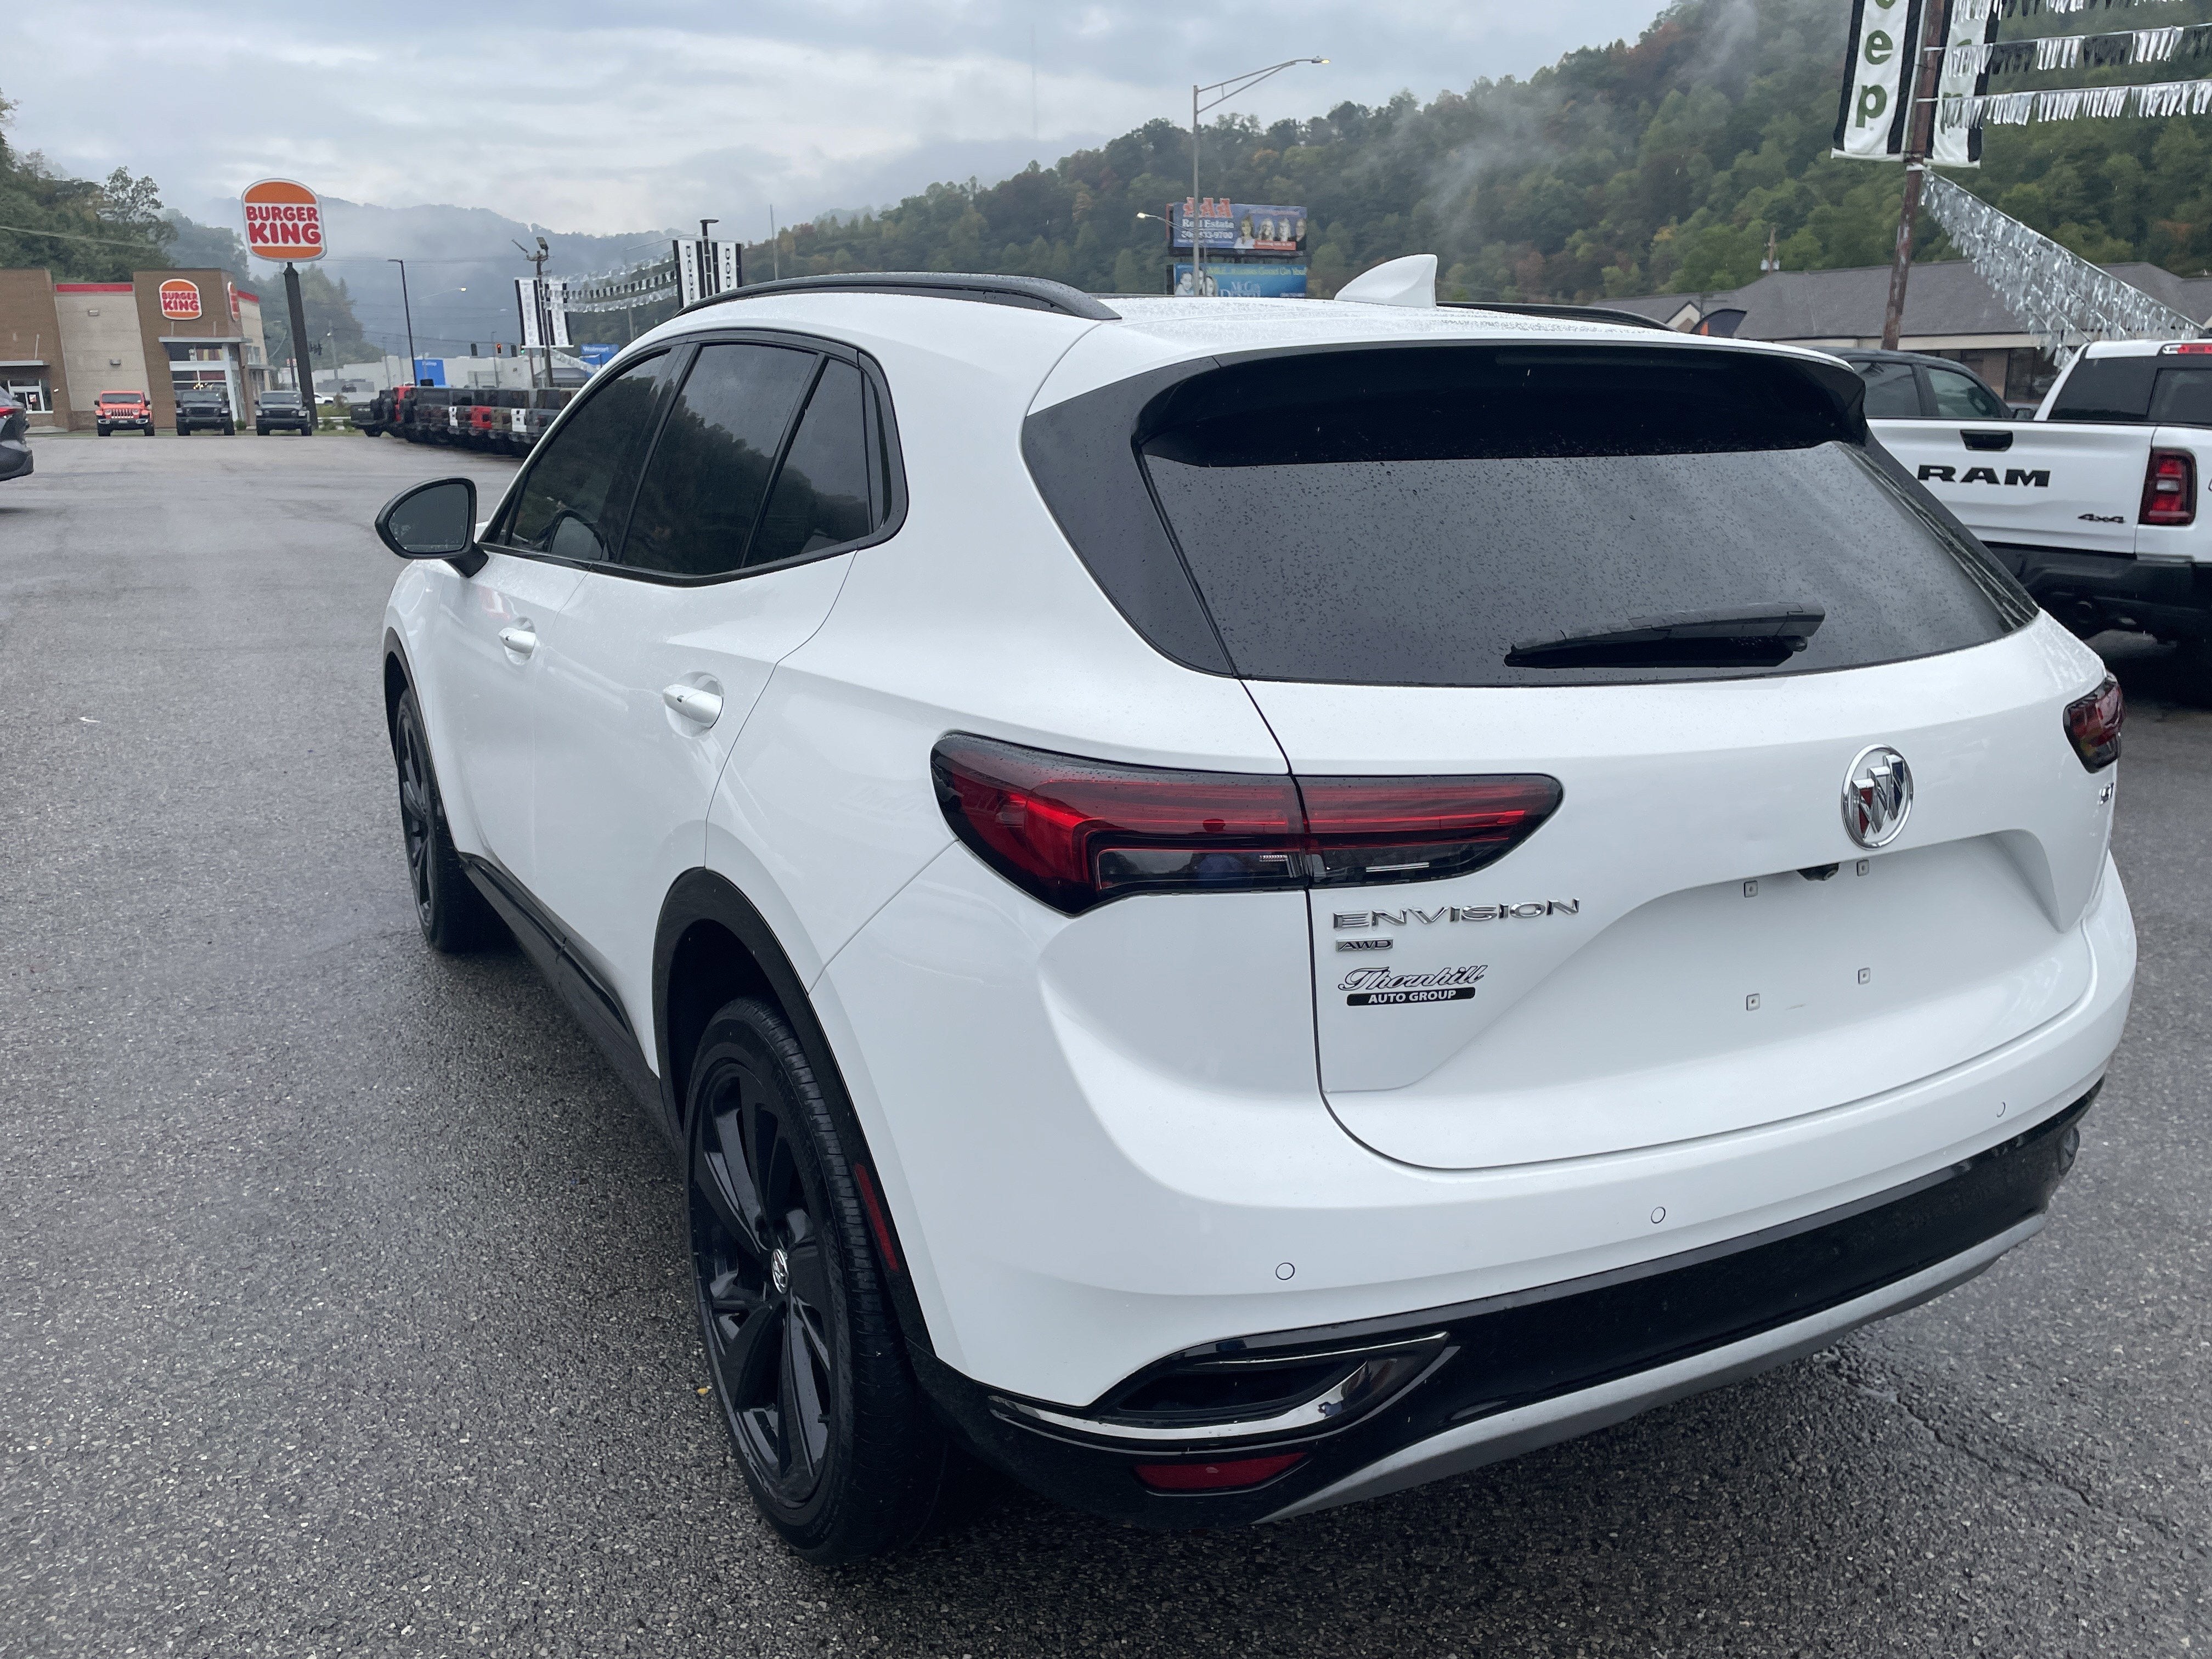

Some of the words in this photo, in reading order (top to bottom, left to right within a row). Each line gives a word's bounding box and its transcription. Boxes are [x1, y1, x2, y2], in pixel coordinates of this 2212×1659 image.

[1855, 0, 1895, 128] ep
[246, 206, 319, 221] BURGER
[1182, 219, 1203, 228] Rel
[249, 222, 321, 244] KING
[685, 246, 693, 303] DODG
[163, 300, 199, 311] KING
[1917, 465, 2050, 487] RAM
[1333, 898, 1580, 929] ENVISION
[1339, 940, 1392, 950] AWD
[1338, 965, 1488, 991] Thornhill
[1368, 992, 1406, 1003] AUTO
[1409, 989, 1457, 1002] GROUP
